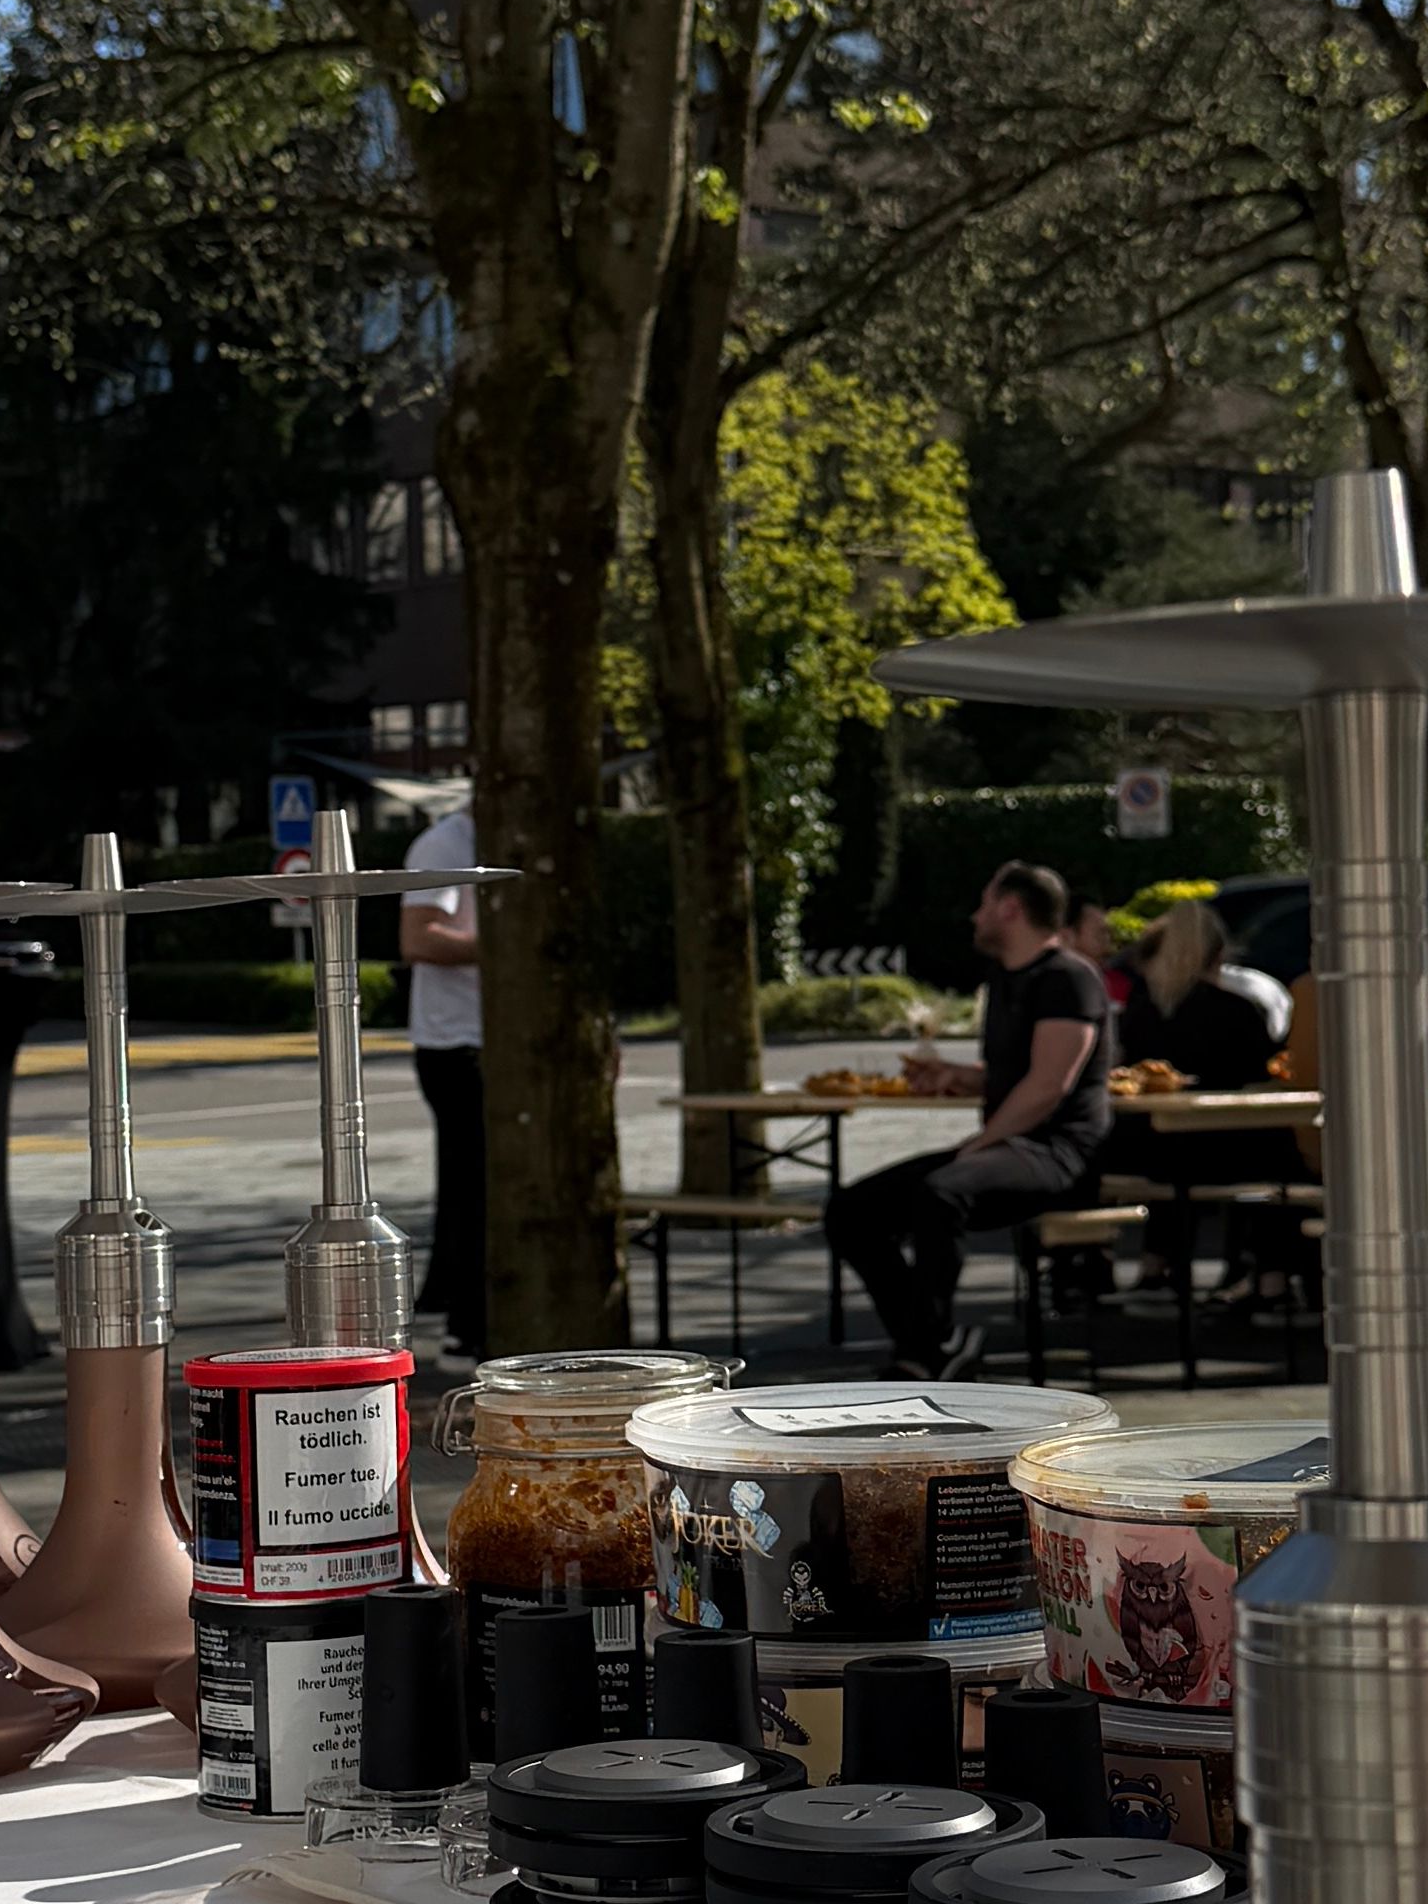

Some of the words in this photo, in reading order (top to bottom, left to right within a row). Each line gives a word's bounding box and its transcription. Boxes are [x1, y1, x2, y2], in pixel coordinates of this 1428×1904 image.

[275, 1406, 357, 1426] Rauchen
[363, 1403, 381, 1420] ist
[299, 1429, 367, 1449] tödlich.
[285, 1470, 345, 1487] Fumer
[350, 1467, 380, 1483] tue.
[268, 1510, 278, 1526] Il
[284, 1506, 334, 1526] fumo
[340, 1500, 394, 1521] uccide.
[938, 1508, 947, 1516] 14
[949, 1507, 972, 1516] Jahre
[671, 1504, 774, 1559] JOKER
[324, 1645, 364, 1659] Rauche
[321, 1661, 342, 1674] und
[298, 1678, 326, 1690] Ihrer
[329, 1676, 361, 1689] Umge
[319, 1710, 354, 1723] Fumer
[344, 1723, 362, 1734] vot
[312, 1739, 339, 1752] celle
[342, 1737, 356, 1749] de
